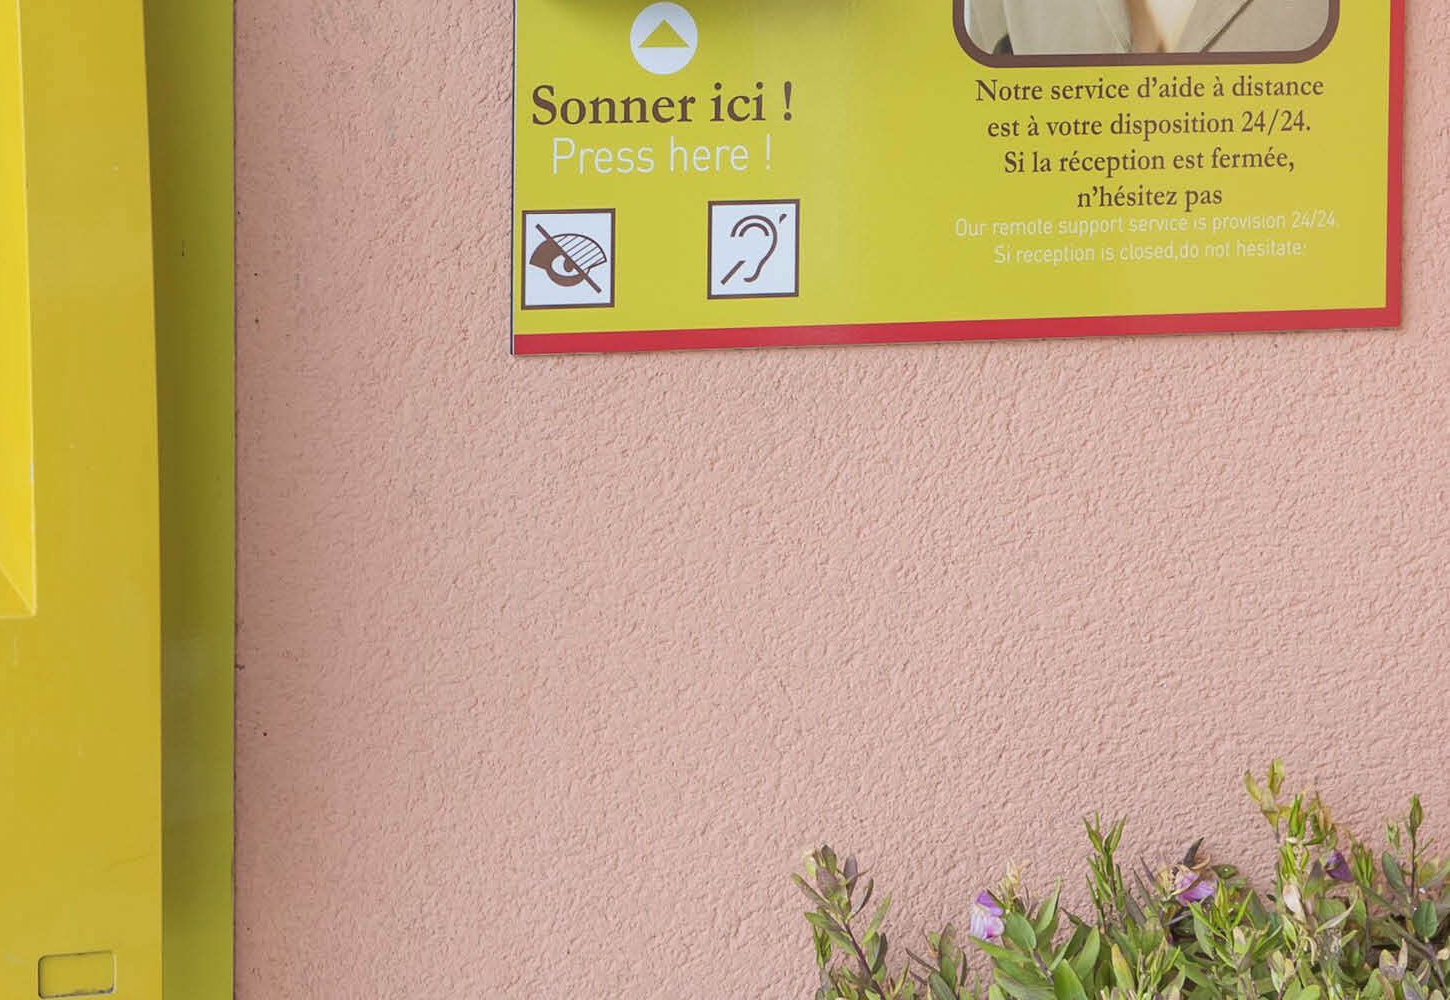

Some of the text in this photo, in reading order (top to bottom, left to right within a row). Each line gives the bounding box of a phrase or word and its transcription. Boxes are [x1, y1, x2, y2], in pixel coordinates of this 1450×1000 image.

[532, 80, 793, 126] Sonner ici !
[974, 75, 1324, 102] Notre service d'aide à distance
[988, 108, 1311, 142] est à votre disposition 24/24.
[552, 133, 772, 175] Press here !
[1004, 146, 1295, 178] Si la réception est fermée,
[1077, 184, 1222, 212] n'hésitez pas
[955, 209, 1339, 242] Our remote support service is provision 24/24.
[994, 244, 1012, 264] Si
[1016, 242, 1095, 267] reception
[1101, 243, 1114, 261] is
[1204, 241, 1231, 258] not
